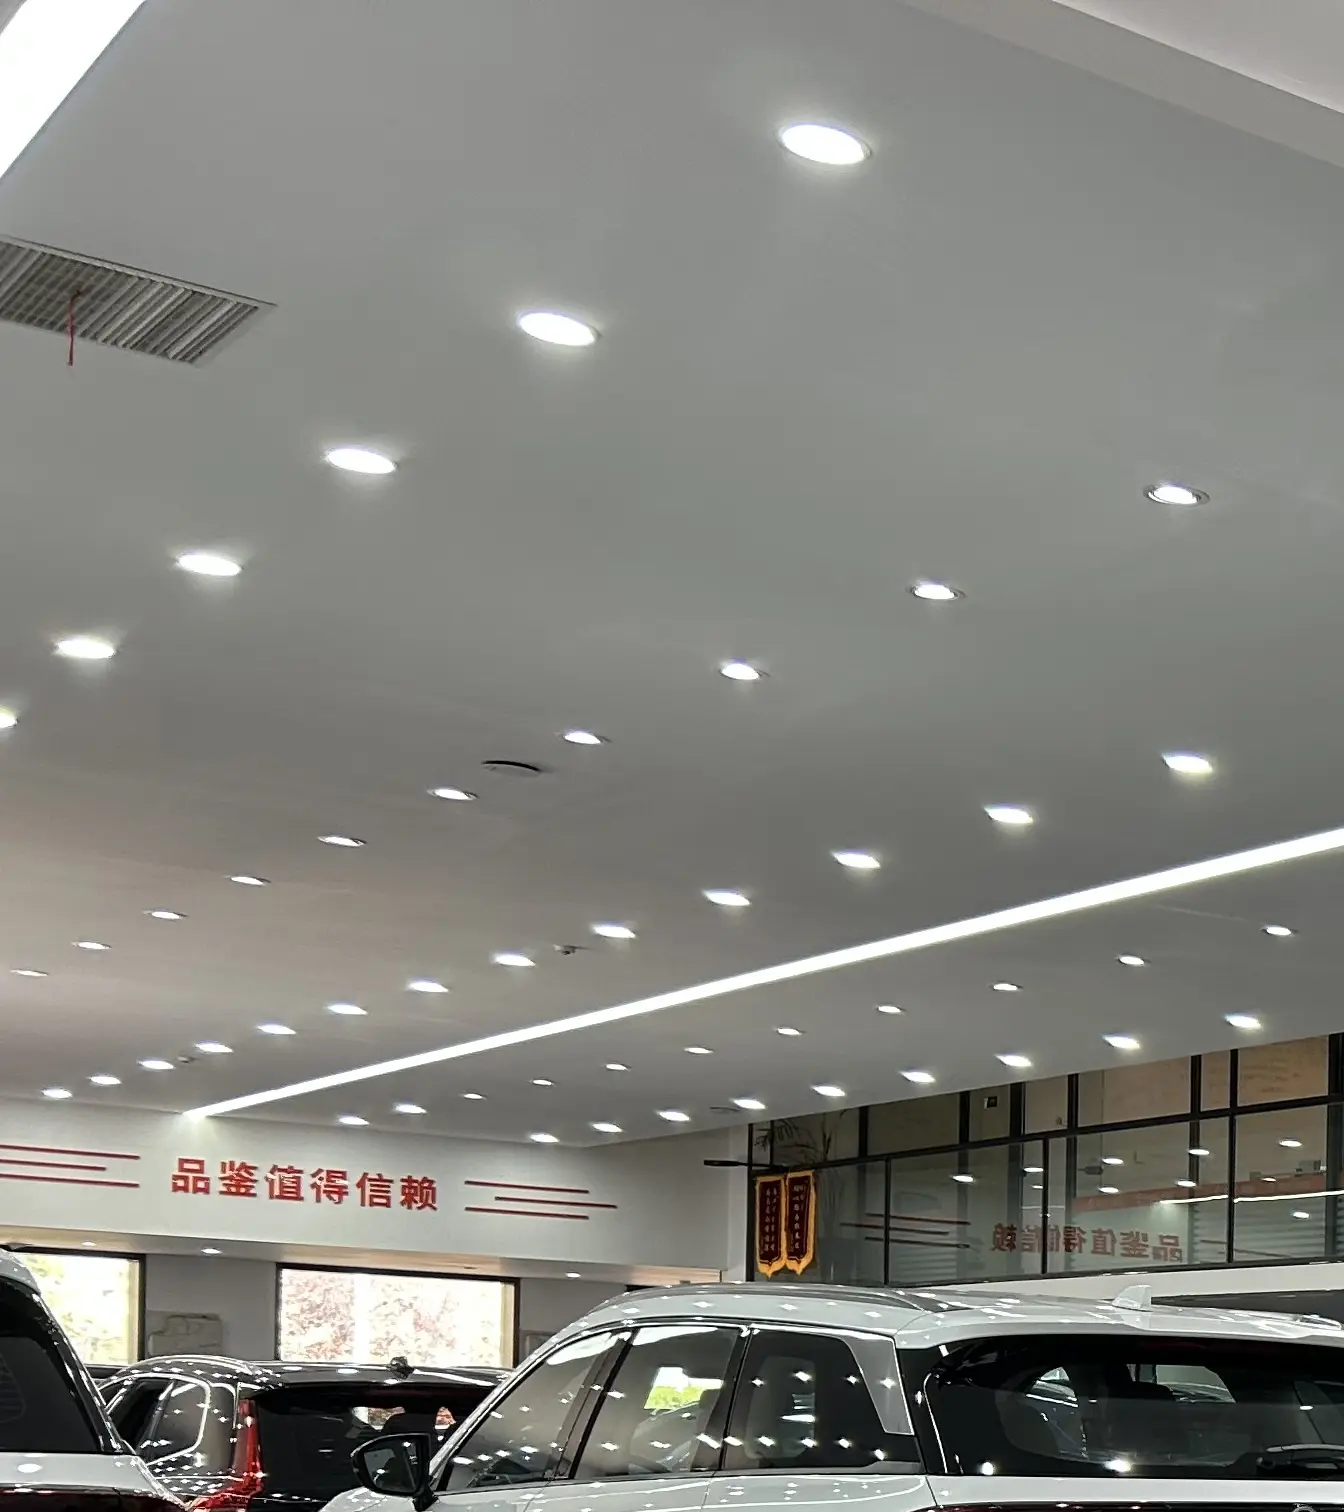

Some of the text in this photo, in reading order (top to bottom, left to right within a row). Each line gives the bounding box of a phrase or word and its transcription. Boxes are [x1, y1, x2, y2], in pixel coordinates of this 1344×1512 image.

[171, 1157, 438, 1212] 品鉴值得信赖
